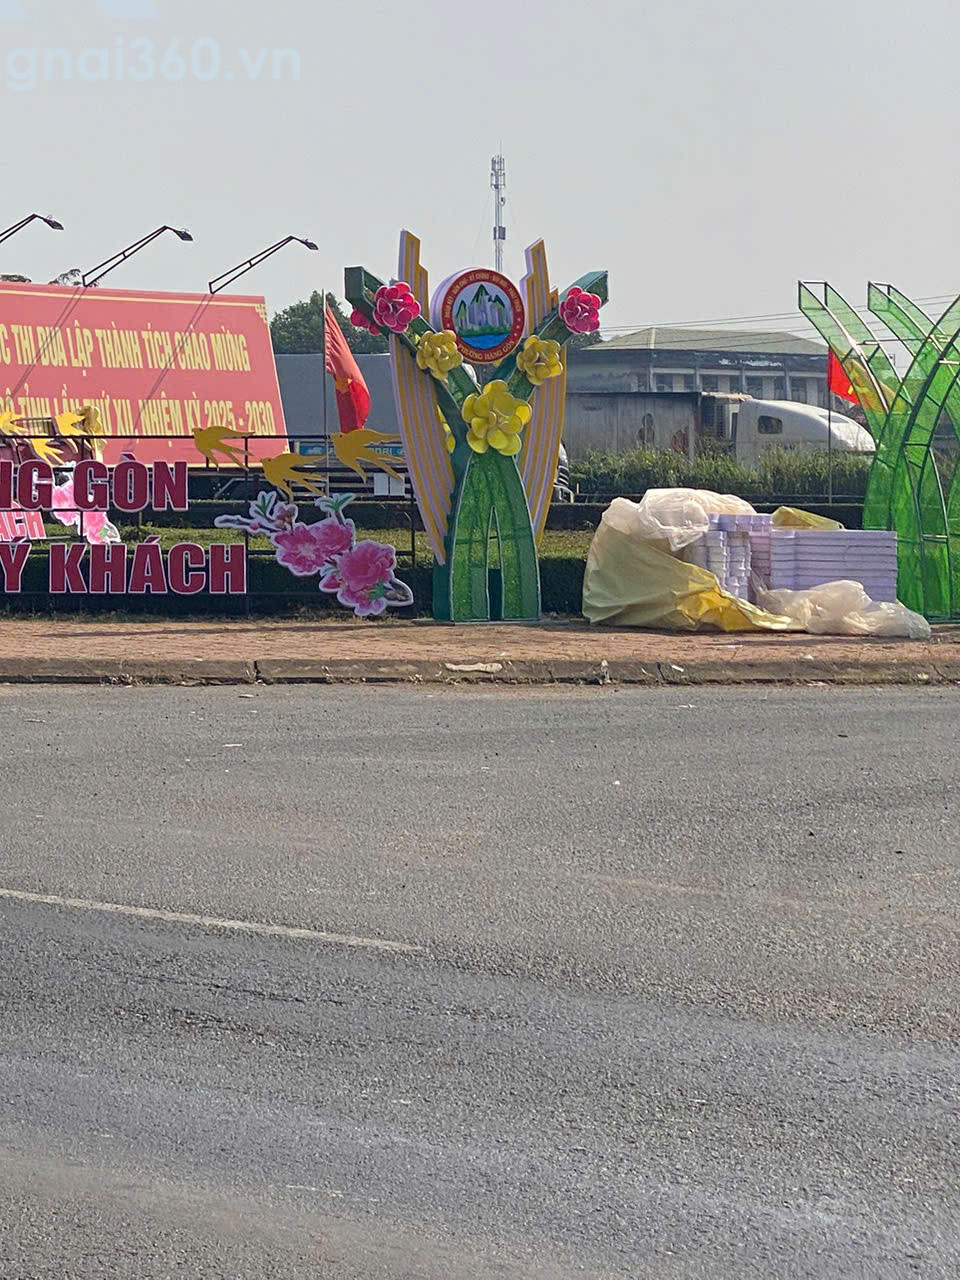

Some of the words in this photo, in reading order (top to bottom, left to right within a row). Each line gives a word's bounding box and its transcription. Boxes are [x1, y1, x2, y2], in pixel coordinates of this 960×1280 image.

[11, 324, 37, 365] THI
[36, 326, 68, 367] ĐUA
[66, 320, 94, 376] LẬP
[95, 321, 144, 369] THÀNH
[141, 322, 176, 369] TÍCH
[174, 324, 211, 370] CHÀO
[209, 325, 252, 372] MỪNG
[183, 391, 202, 436] KỲ
[204, 400, 238, 431] 2025
[244, 400, 277, 436] 2030
[72, 451, 189, 512] GÒN
[48, 535, 247, 594] KHÁCH
